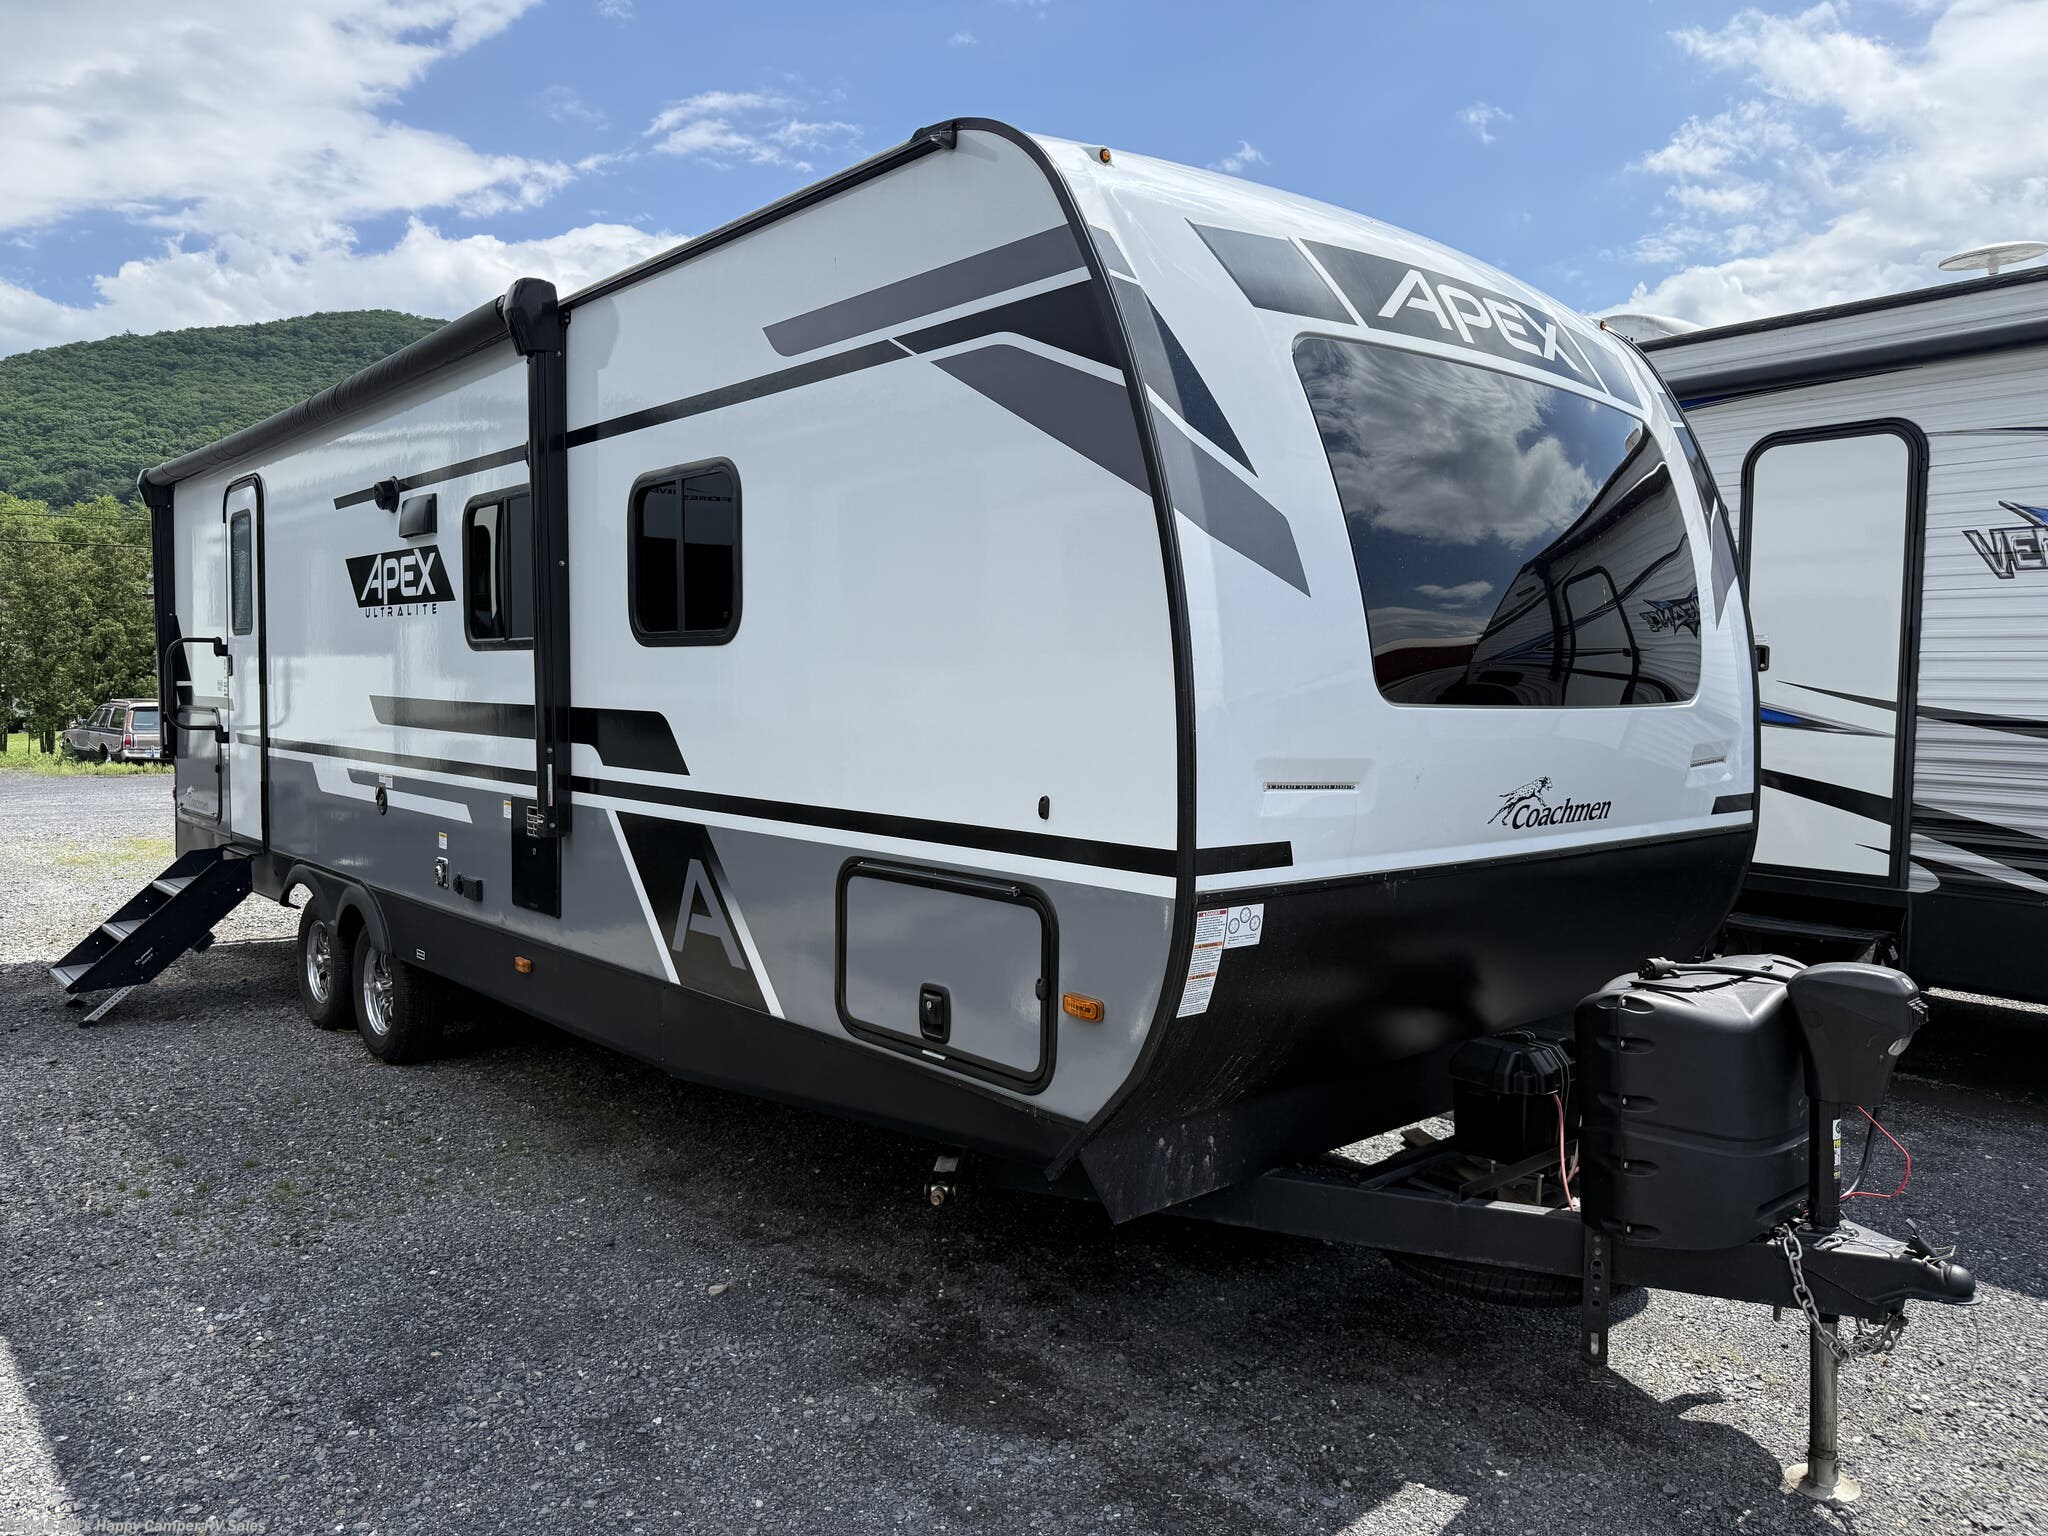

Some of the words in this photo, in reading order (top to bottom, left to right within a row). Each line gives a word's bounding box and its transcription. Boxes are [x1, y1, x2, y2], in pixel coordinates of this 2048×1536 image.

[1377, 268, 1583, 374] APEX
[360, 547, 437, 606] APEX
[364, 602, 438, 619] ULTRALITE
[1511, 796, 1612, 830] Coachmen
